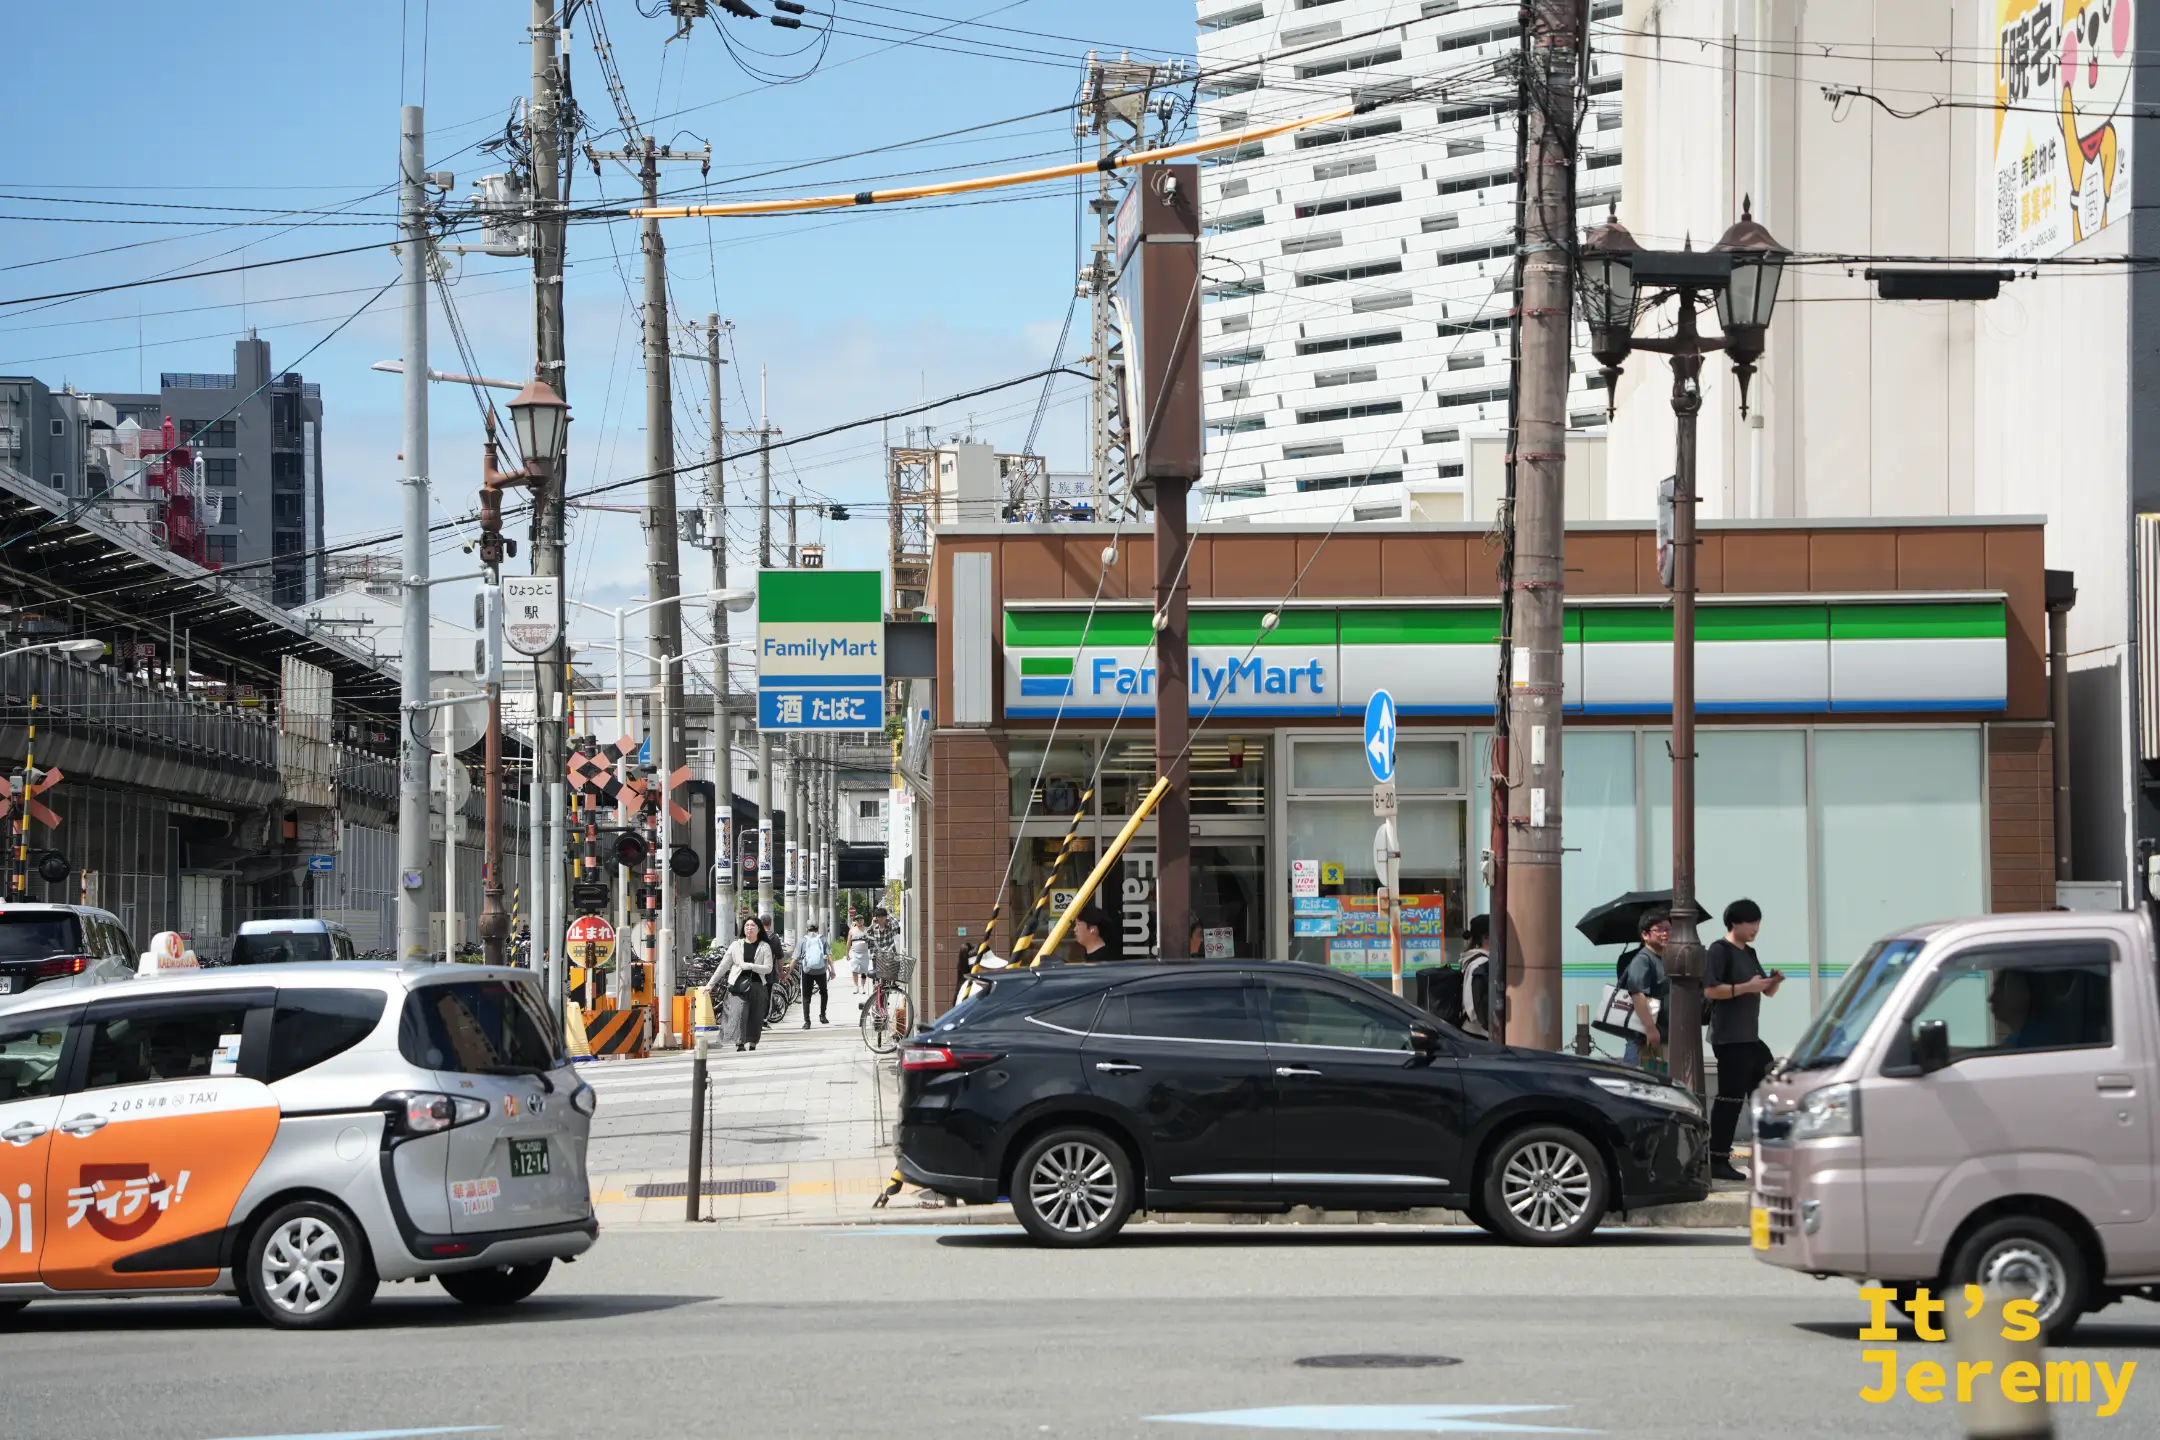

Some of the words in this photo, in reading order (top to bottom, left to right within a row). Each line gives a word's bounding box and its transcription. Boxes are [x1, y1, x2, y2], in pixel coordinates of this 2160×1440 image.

[509, 584, 552, 596] ひょっとこ
[524, 605, 539, 619] 駅
[764, 638, 877, 661] FamilyMart
[1092, 656, 1324, 701] FalyMart
[776, 695, 803, 724] 酒
[811, 697, 866, 721] たばこ
[1375, 792, 1394, 808] 8-20
[1122, 852, 1158, 956] Fami
[1301, 899, 1331, 909] たばこ
[570, 926, 611, 940] 止まれ
[189, 1091, 218, 1105] TAXI
[67, 1170, 191, 1228] ディディ!
[0, 1183, 32, 1254] i
